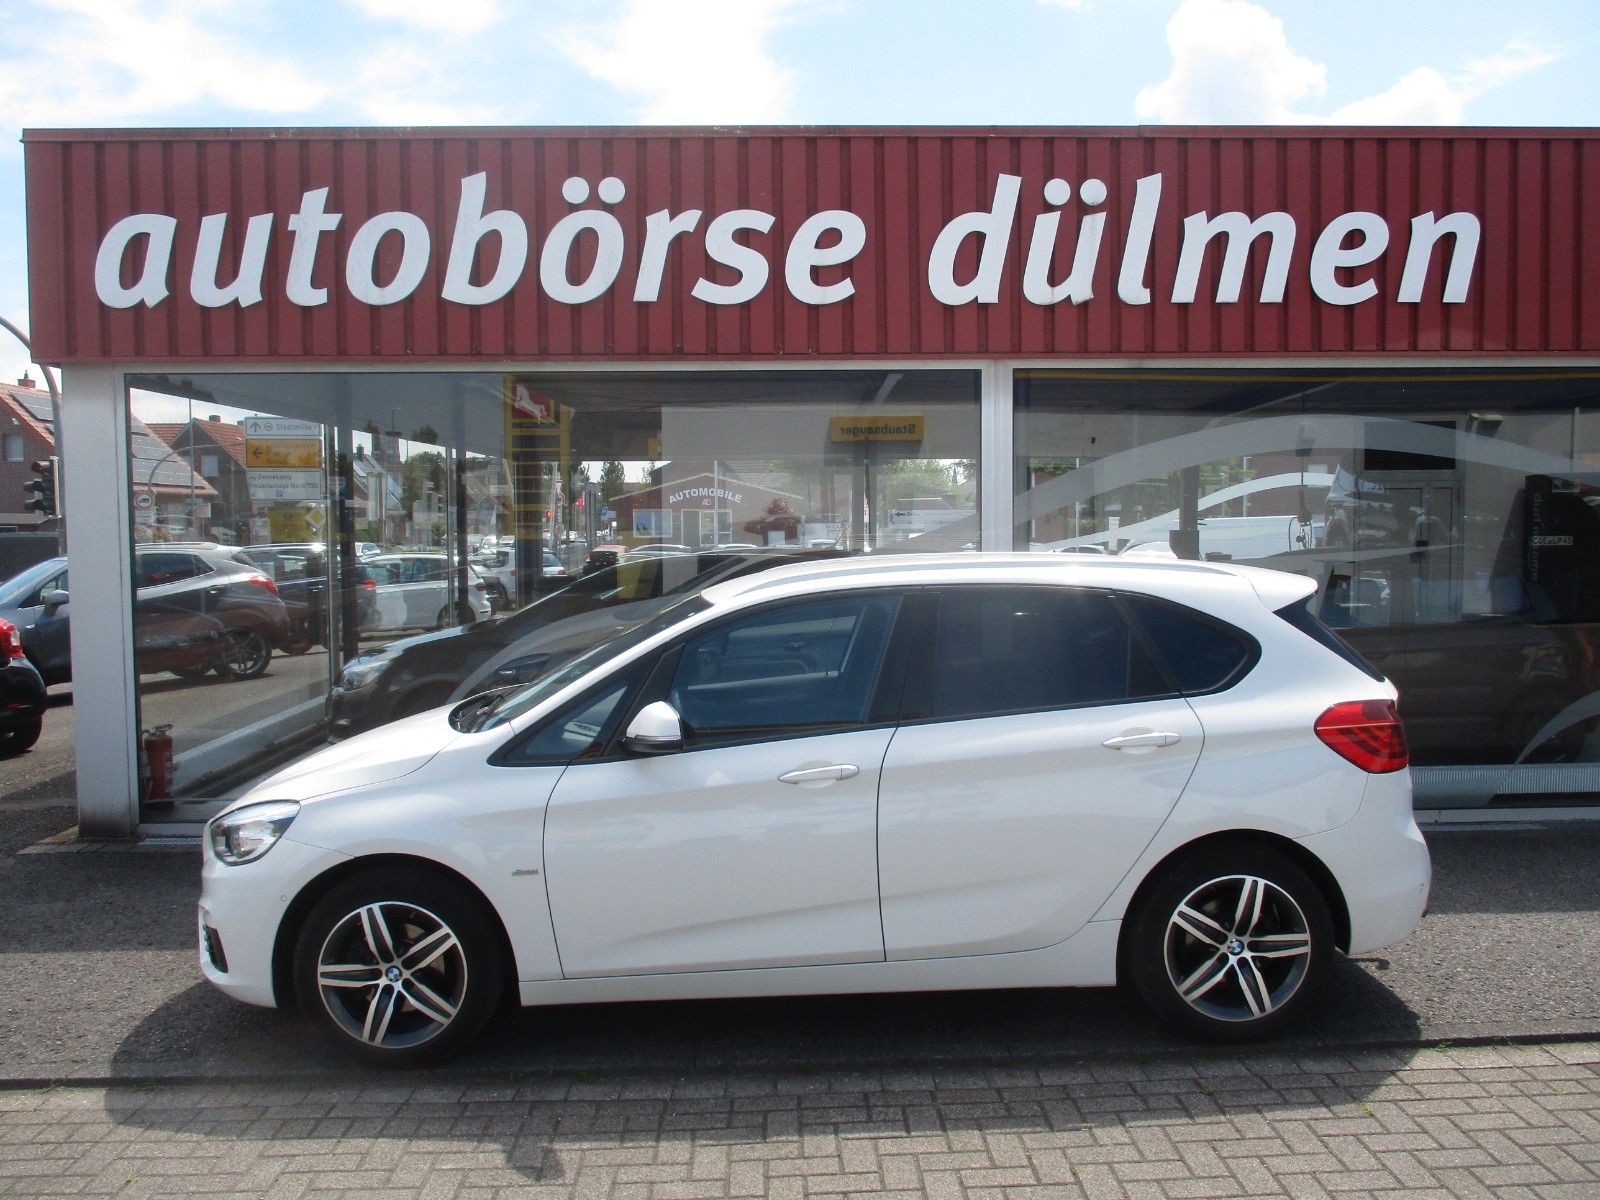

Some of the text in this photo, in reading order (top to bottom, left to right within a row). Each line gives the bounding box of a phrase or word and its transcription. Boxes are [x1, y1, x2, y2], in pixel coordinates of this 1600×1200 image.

[94, 171, 1481, 308] autobörse dülmen
[669, 487, 743, 504] AUTOMOBILE
